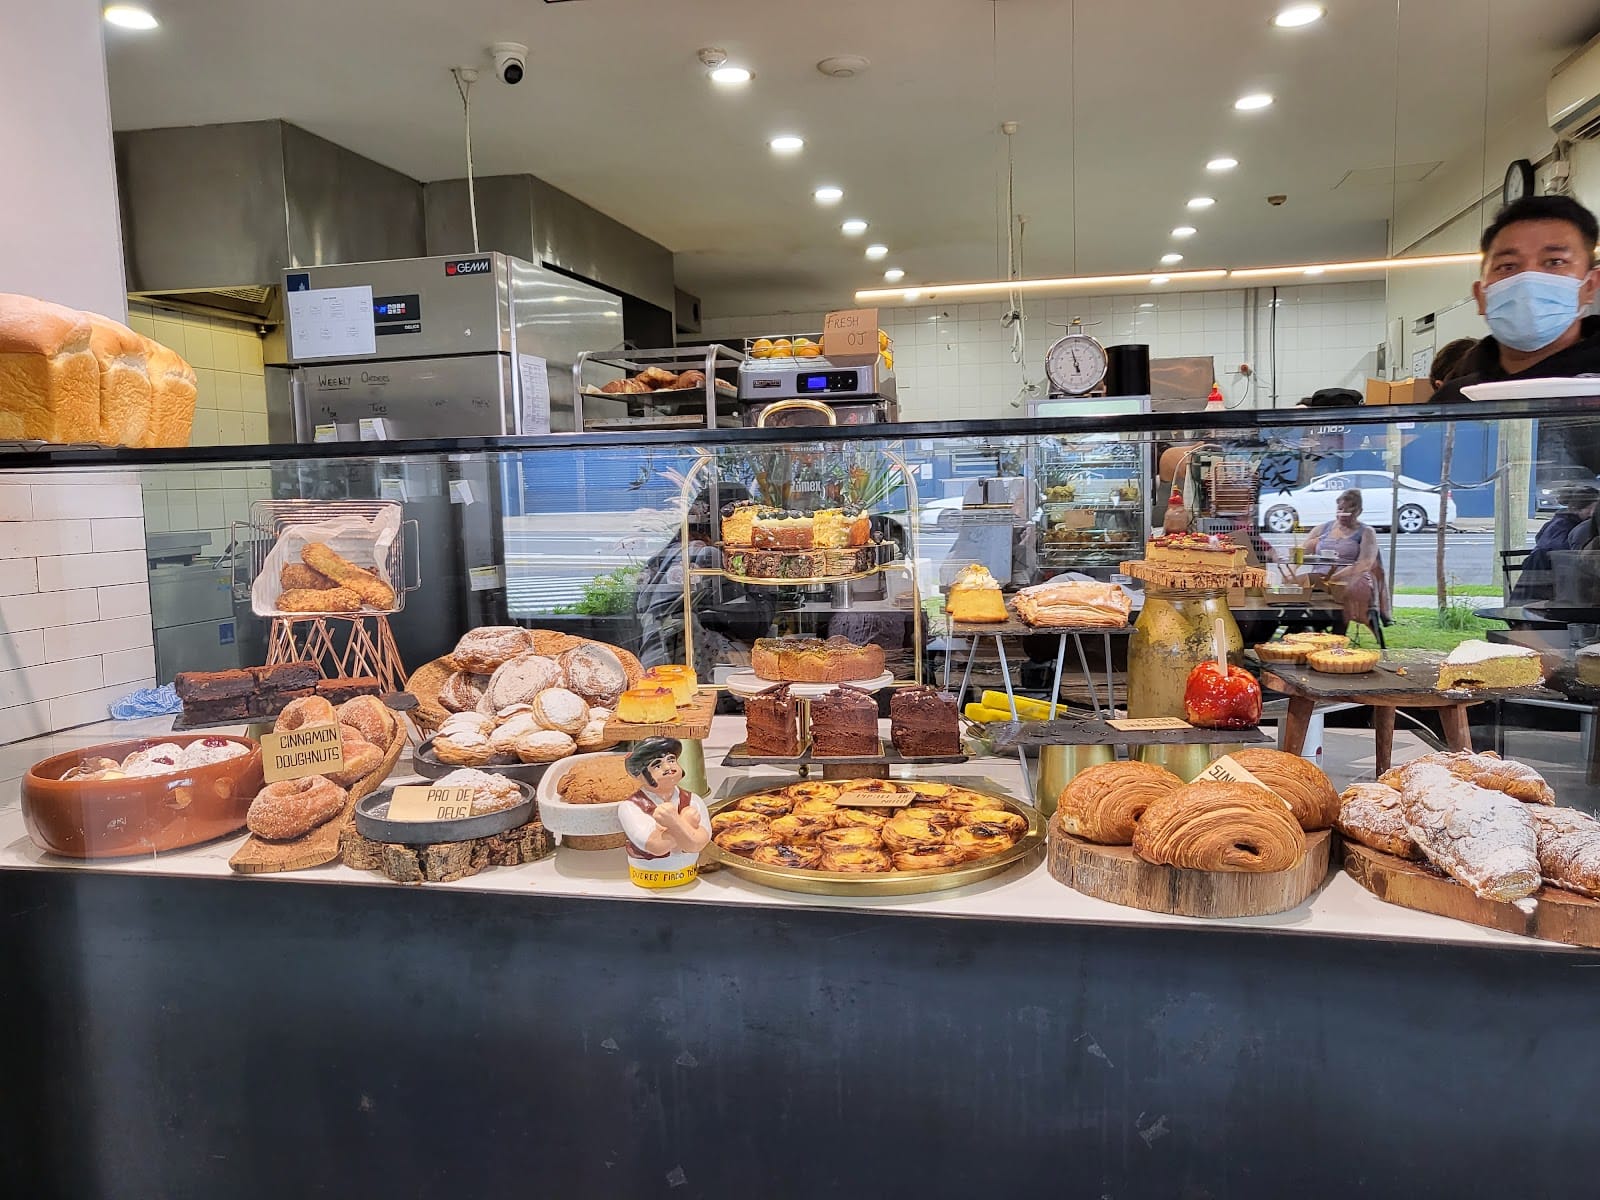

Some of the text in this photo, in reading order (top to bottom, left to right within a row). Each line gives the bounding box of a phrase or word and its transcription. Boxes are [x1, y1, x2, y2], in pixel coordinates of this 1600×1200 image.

[457, 261, 489, 273] GEMM
[826, 313, 860, 329] FRESH
[847, 331, 867, 346] OJ
[279, 727, 337, 749] CINNAMON
[275, 746, 340, 769] DOUGHNUTS
[1208, 764, 1237, 783] SIN
[455, 788, 472, 802] DE
[436, 806, 467, 819] DEUS
